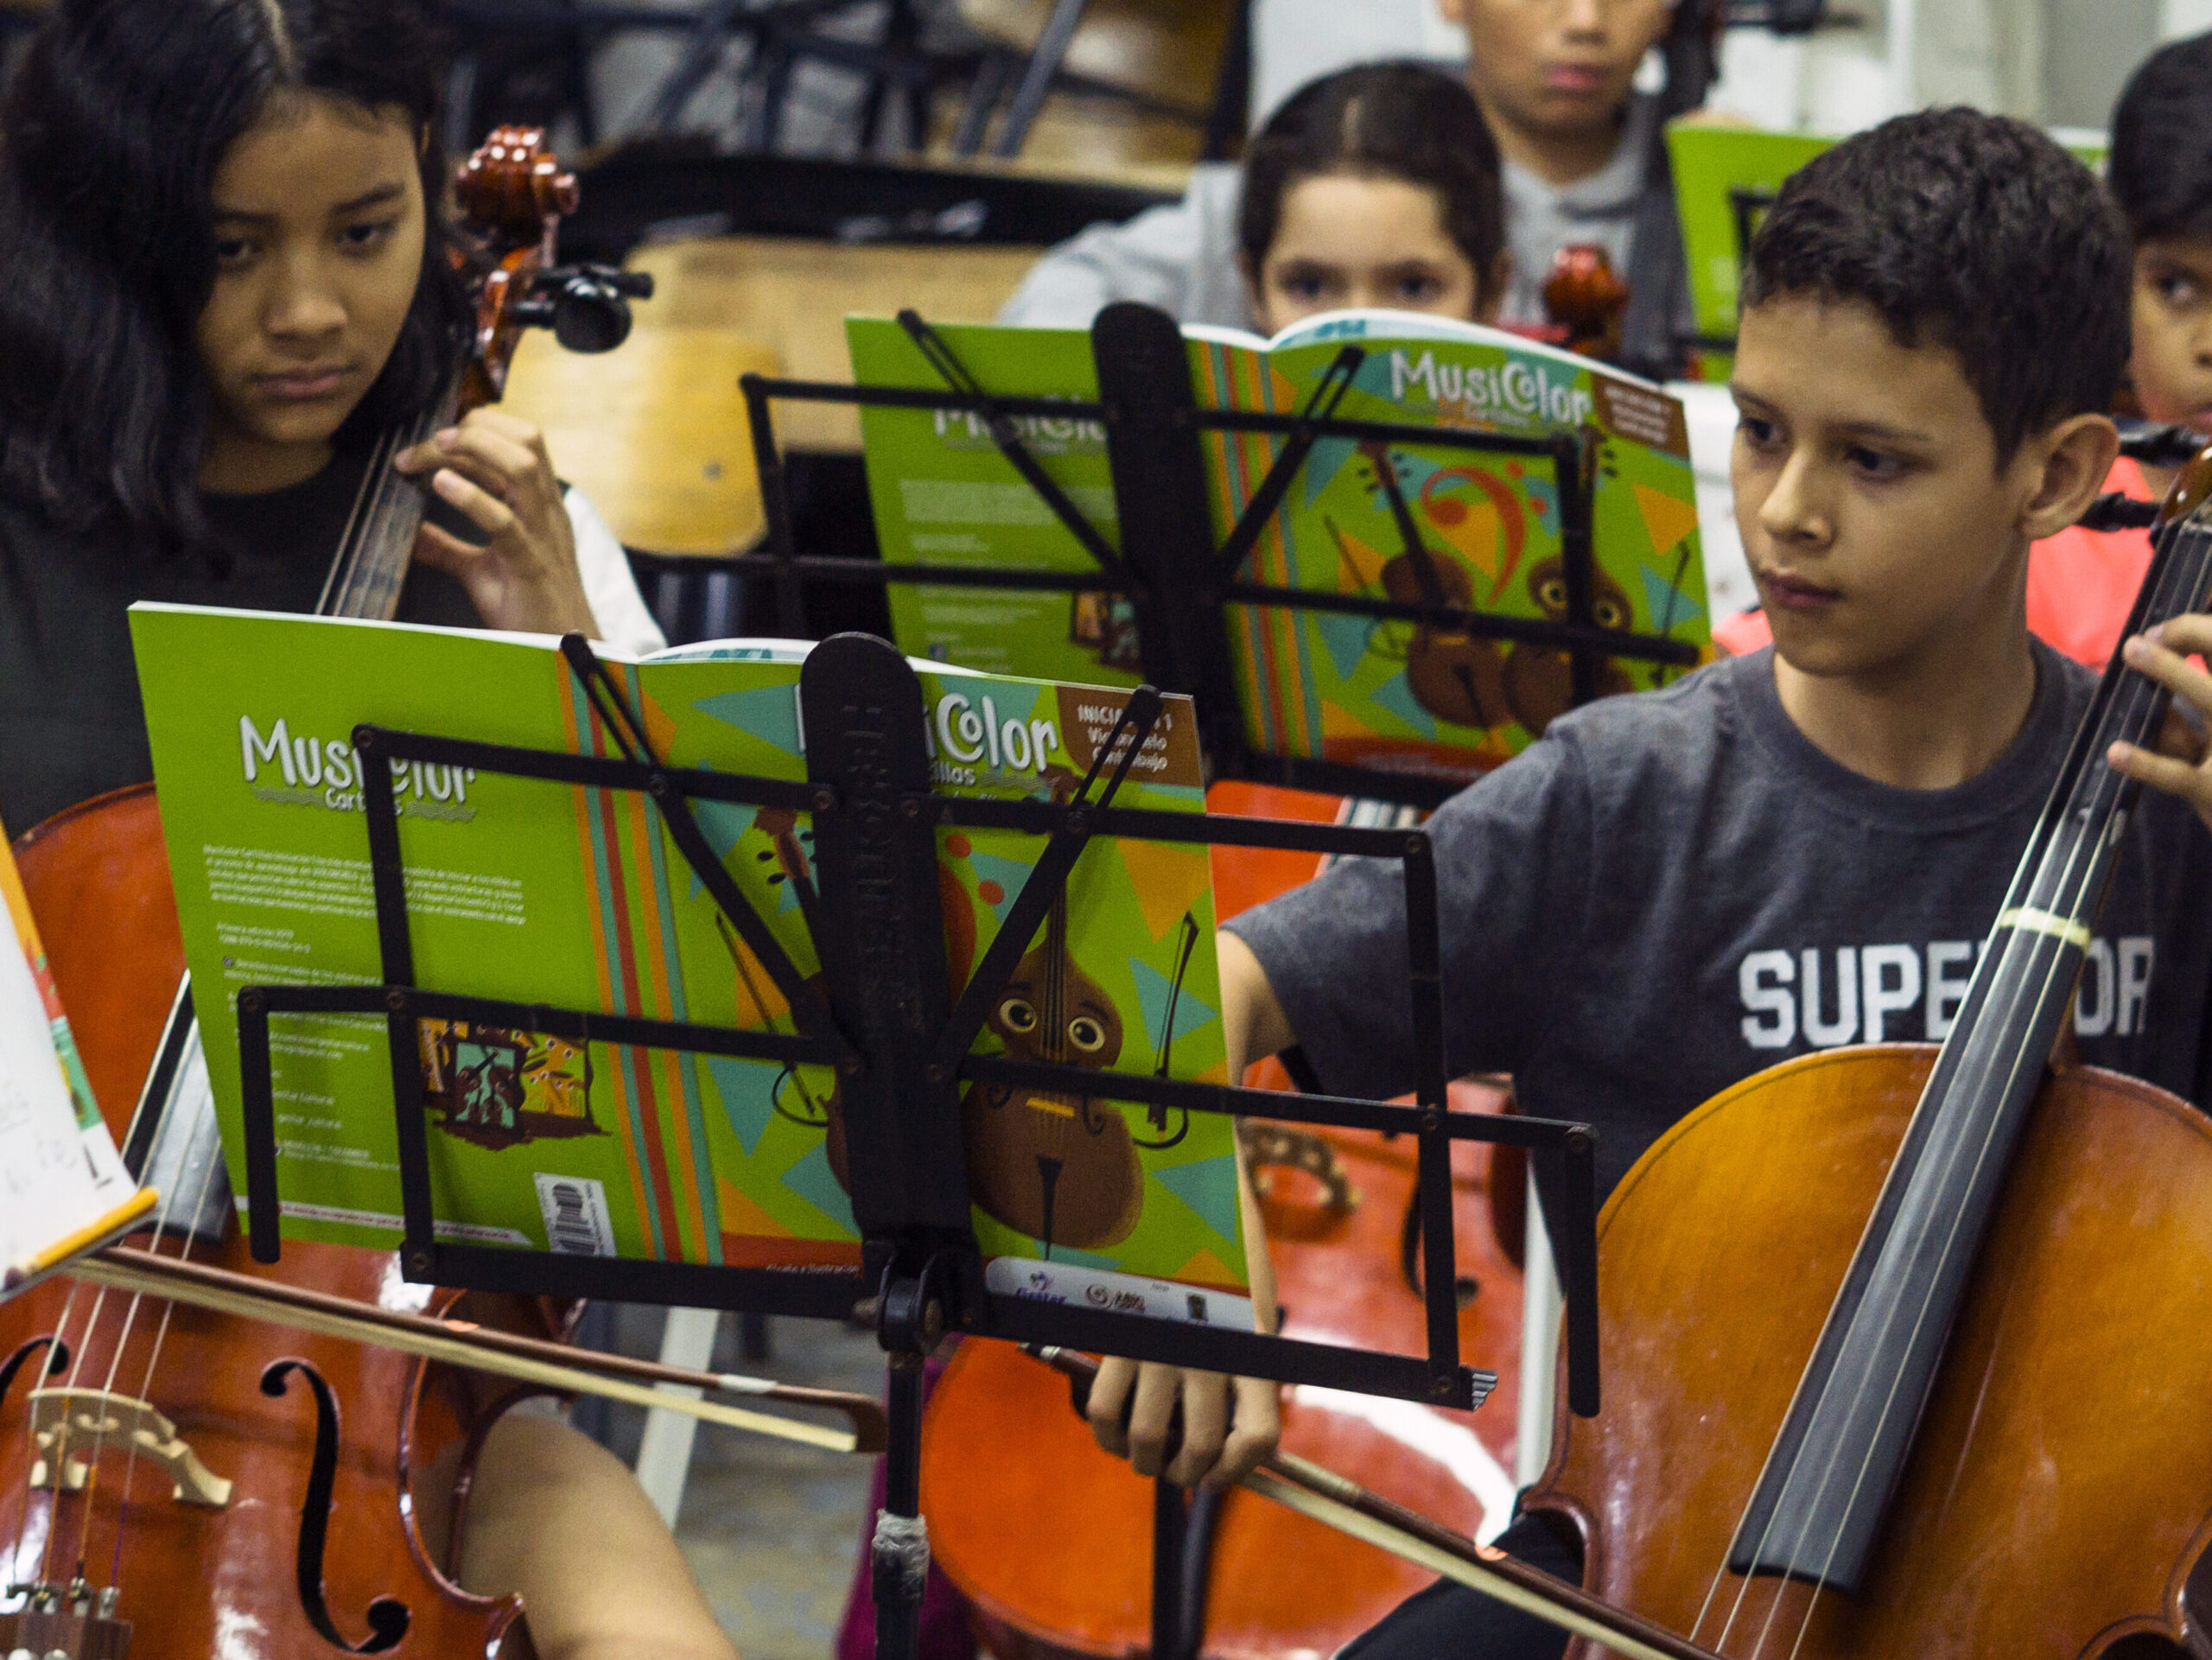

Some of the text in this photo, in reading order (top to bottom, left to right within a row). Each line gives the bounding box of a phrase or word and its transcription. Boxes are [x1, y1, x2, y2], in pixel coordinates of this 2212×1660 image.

[1390, 349, 1592, 425] MusiColor
[238, 715, 476, 805] Musiolor
[1738, 936, 2155, 1049] SUPEOR
